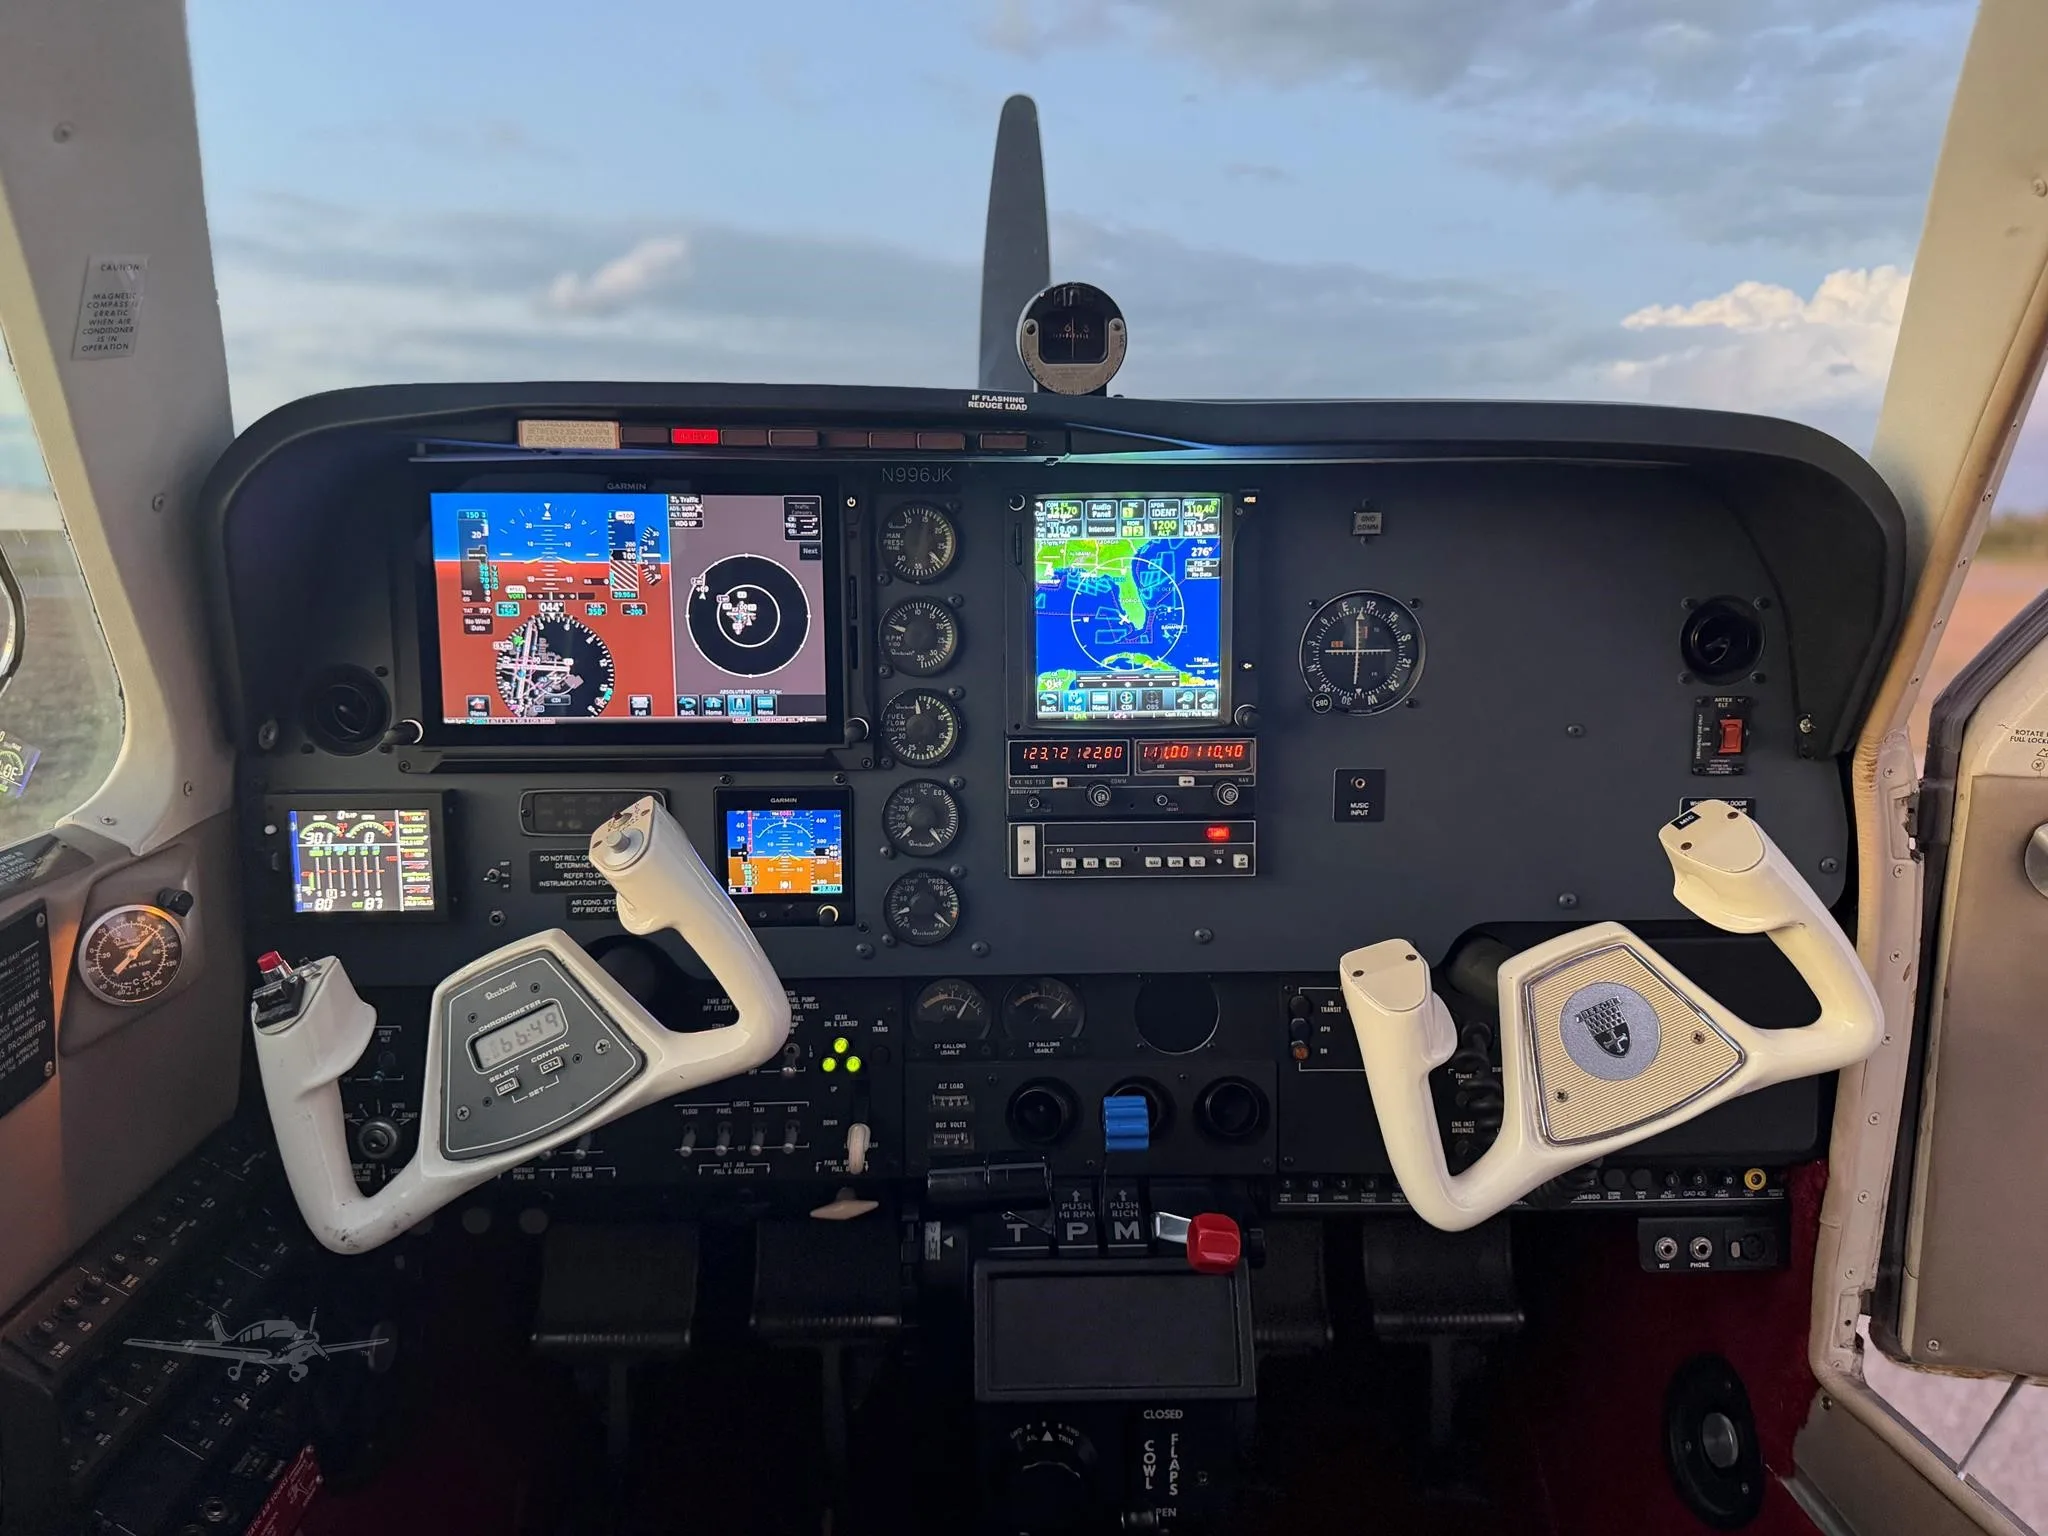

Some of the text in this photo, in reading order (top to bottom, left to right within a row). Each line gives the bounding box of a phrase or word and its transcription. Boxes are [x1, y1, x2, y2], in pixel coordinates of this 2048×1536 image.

[81, 326, 134, 335] CONDITIONER
[81, 343, 129, 352] OPERATION
[981, 394, 1025, 404] FLASHING
[967, 400, 1028, 411] REDUCE LOAD
[882, 467, 953, 482] N996JK
[606, 482, 647, 491] GARMIN
[679, 496, 699, 504] Traffic
[1049, 506, 1078, 516] 121.70
[1091, 503, 1112, 511] Audio
[1187, 504, 1215, 514] 110.40
[1092, 510, 1112, 518] Panel
[1151, 508, 1177, 517] IDENT
[1152, 520, 1177, 531] 1200
[802, 547, 819, 555] Next
[1190, 546, 1213, 557] 276°
[1342, 602, 1349, 612] E
[1365, 600, 1377, 610] 12
[1321, 617, 1329, 625] 6
[1389, 611, 1398, 622] 15
[916, 654, 925, 662] 35
[1402, 658, 1412, 668] 21
[1306, 664, 1317, 673] N
[1319, 683, 1331, 693] 33
[1388, 680, 1400, 692] 24
[1341, 696, 1352, 705] 30
[1367, 695, 1378, 705] W
[2015, 729, 2044, 738] ROTATE
[2010, 735, 2026, 743] FULL
[1022, 745, 1123, 760] 123.72 122.80
[1143, 744, 1244, 760] 111.00 110.40
[1679, 815, 1695, 826] MIC
[305, 831, 333, 845] 30.1
[927, 877, 949, 886] PRESS
[314, 898, 333, 912] 80
[7, 989, 40, 1017] AIRPLANE
[477, 1000, 542, 1032] CHRONOMETER
[8, 1019, 47, 1052] PROHIBITED
[530, 1042, 570, 1063] CONTROL
[541, 1059, 560, 1070] CTL
[489, 1065, 520, 1083] SELECT
[497, 1083, 515, 1093] SEL
[528, 1085, 545, 1097] SET
[1061, 1202, 1092, 1210] PUSH
[1109, 1201, 1140, 1210] PUSH
[1111, 1209, 1139, 1217] RICH
[1006, 1223, 1029, 1242] T
[1066, 1221, 1089, 1241] P
[1113, 1220, 1140, 1240] M
[1143, 1409, 1184, 1420] CLOSED
[1058, 1433, 1074, 1446] TRIM
[1143, 1439, 1156, 1490] COWL
[1169, 1433, 1181, 1496] FLAPS
